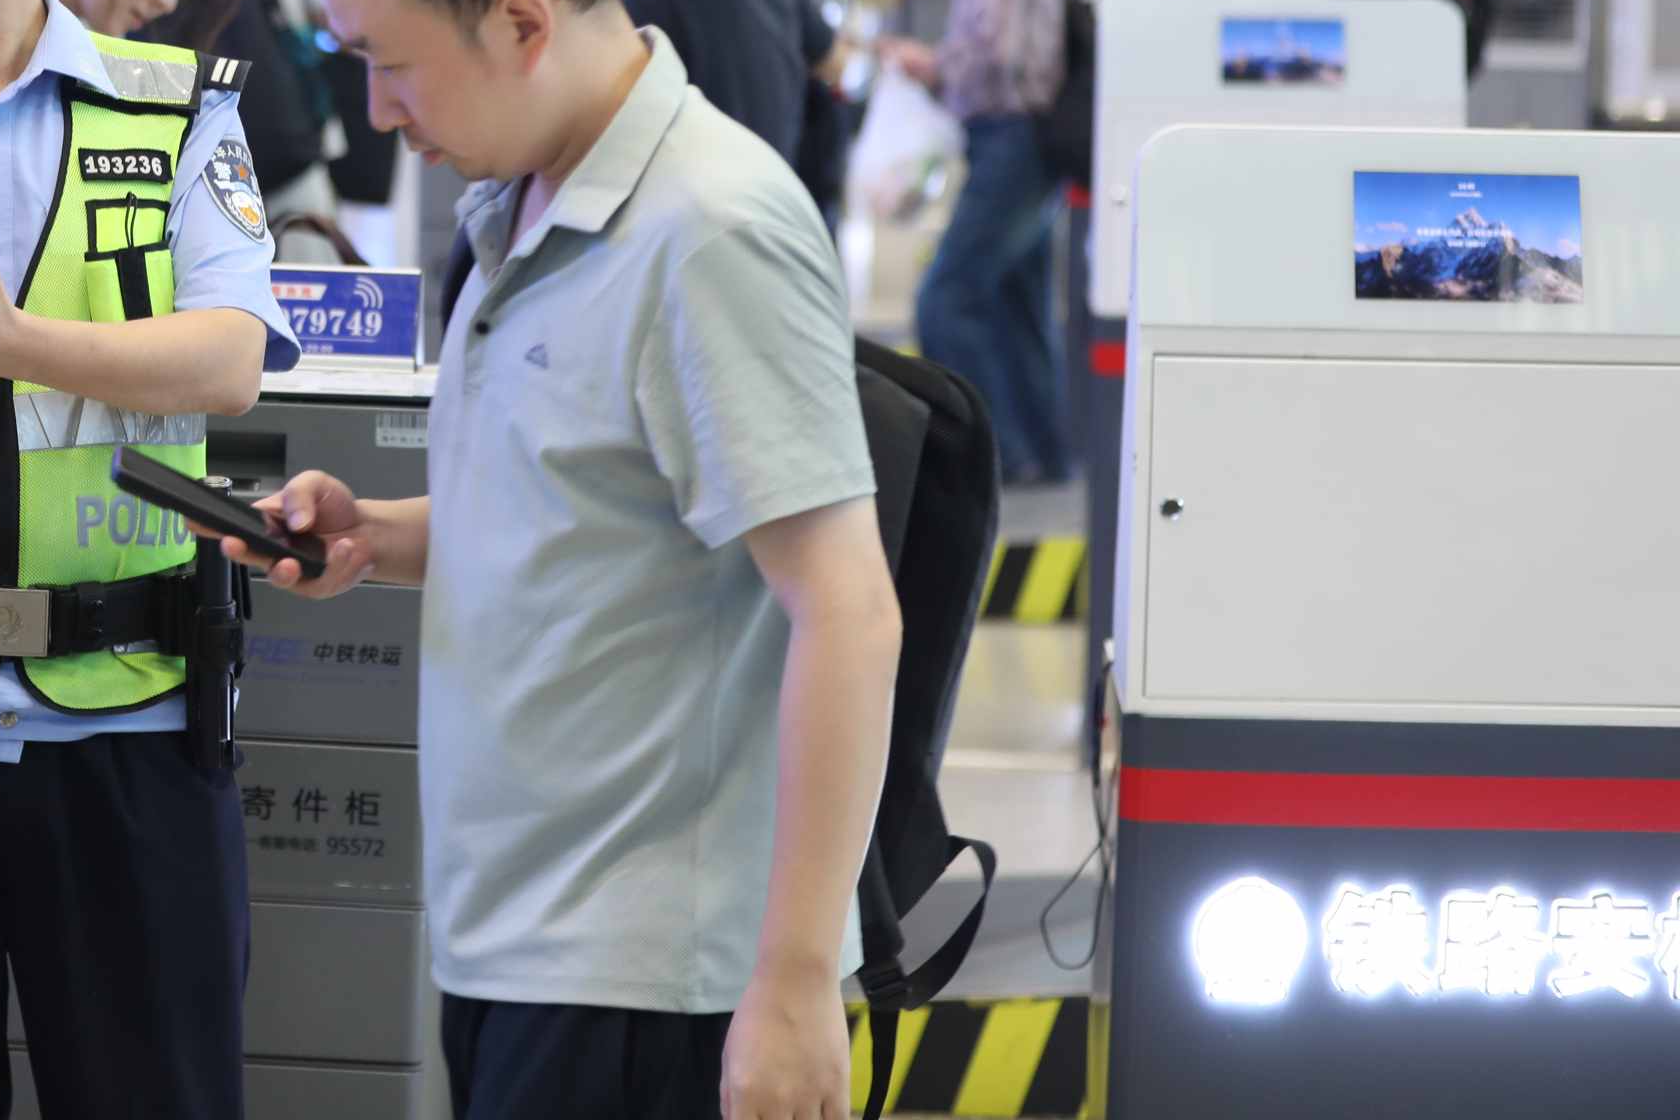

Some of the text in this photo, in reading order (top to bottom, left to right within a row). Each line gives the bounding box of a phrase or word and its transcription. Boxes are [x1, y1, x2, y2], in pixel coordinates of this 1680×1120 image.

[84, 155, 163, 177] 193236
[75, 495, 197, 548] POLIC
[313, 642, 403, 666] 中铁快运
[240, 785, 382, 827] 寄件柜
[326, 837, 385, 858] 95572
[1325, 882, 1680, 1000] 铁路安
